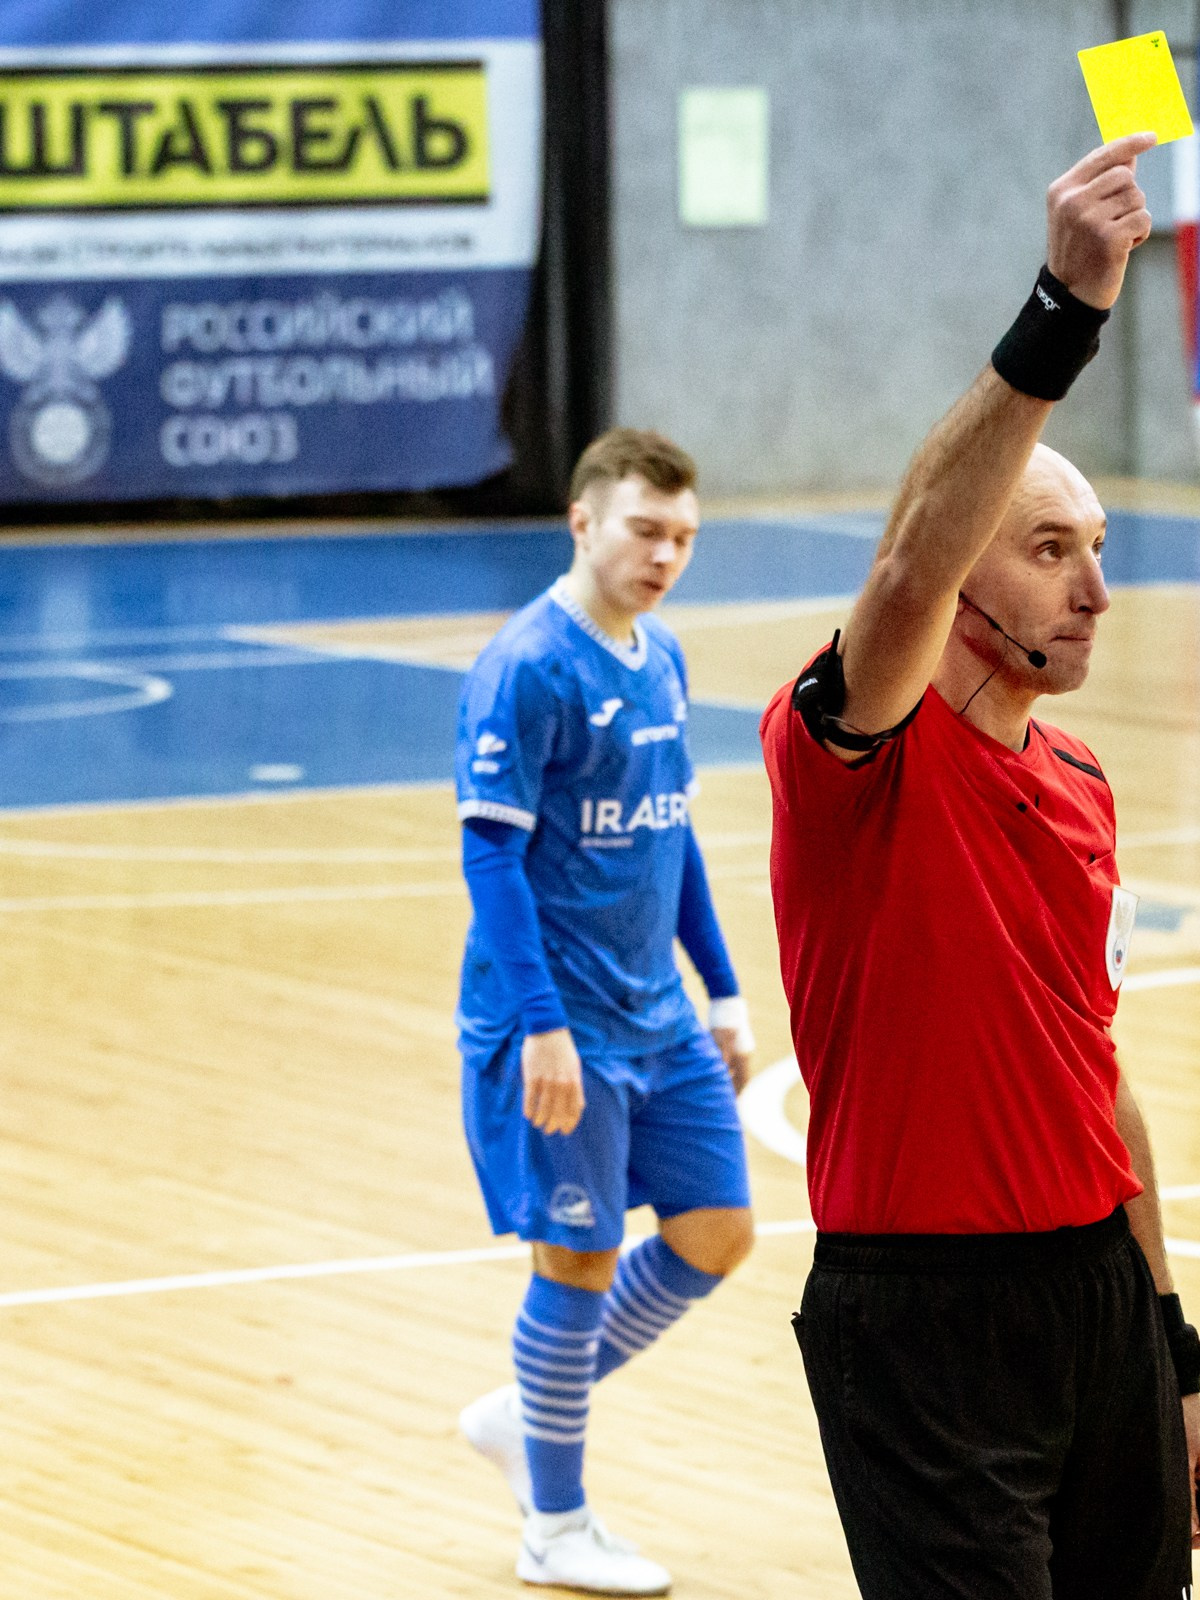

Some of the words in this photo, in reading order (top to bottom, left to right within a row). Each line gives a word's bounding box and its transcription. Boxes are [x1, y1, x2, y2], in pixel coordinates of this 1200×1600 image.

[0, 94, 470, 179] ШТАБЕЛЬ
[163, 287, 473, 352] РОССИЙСКИЙ
[161, 346, 494, 407] ФУТБОЛЬНЫЙ
[161, 414, 298, 467] СОЮЗ
